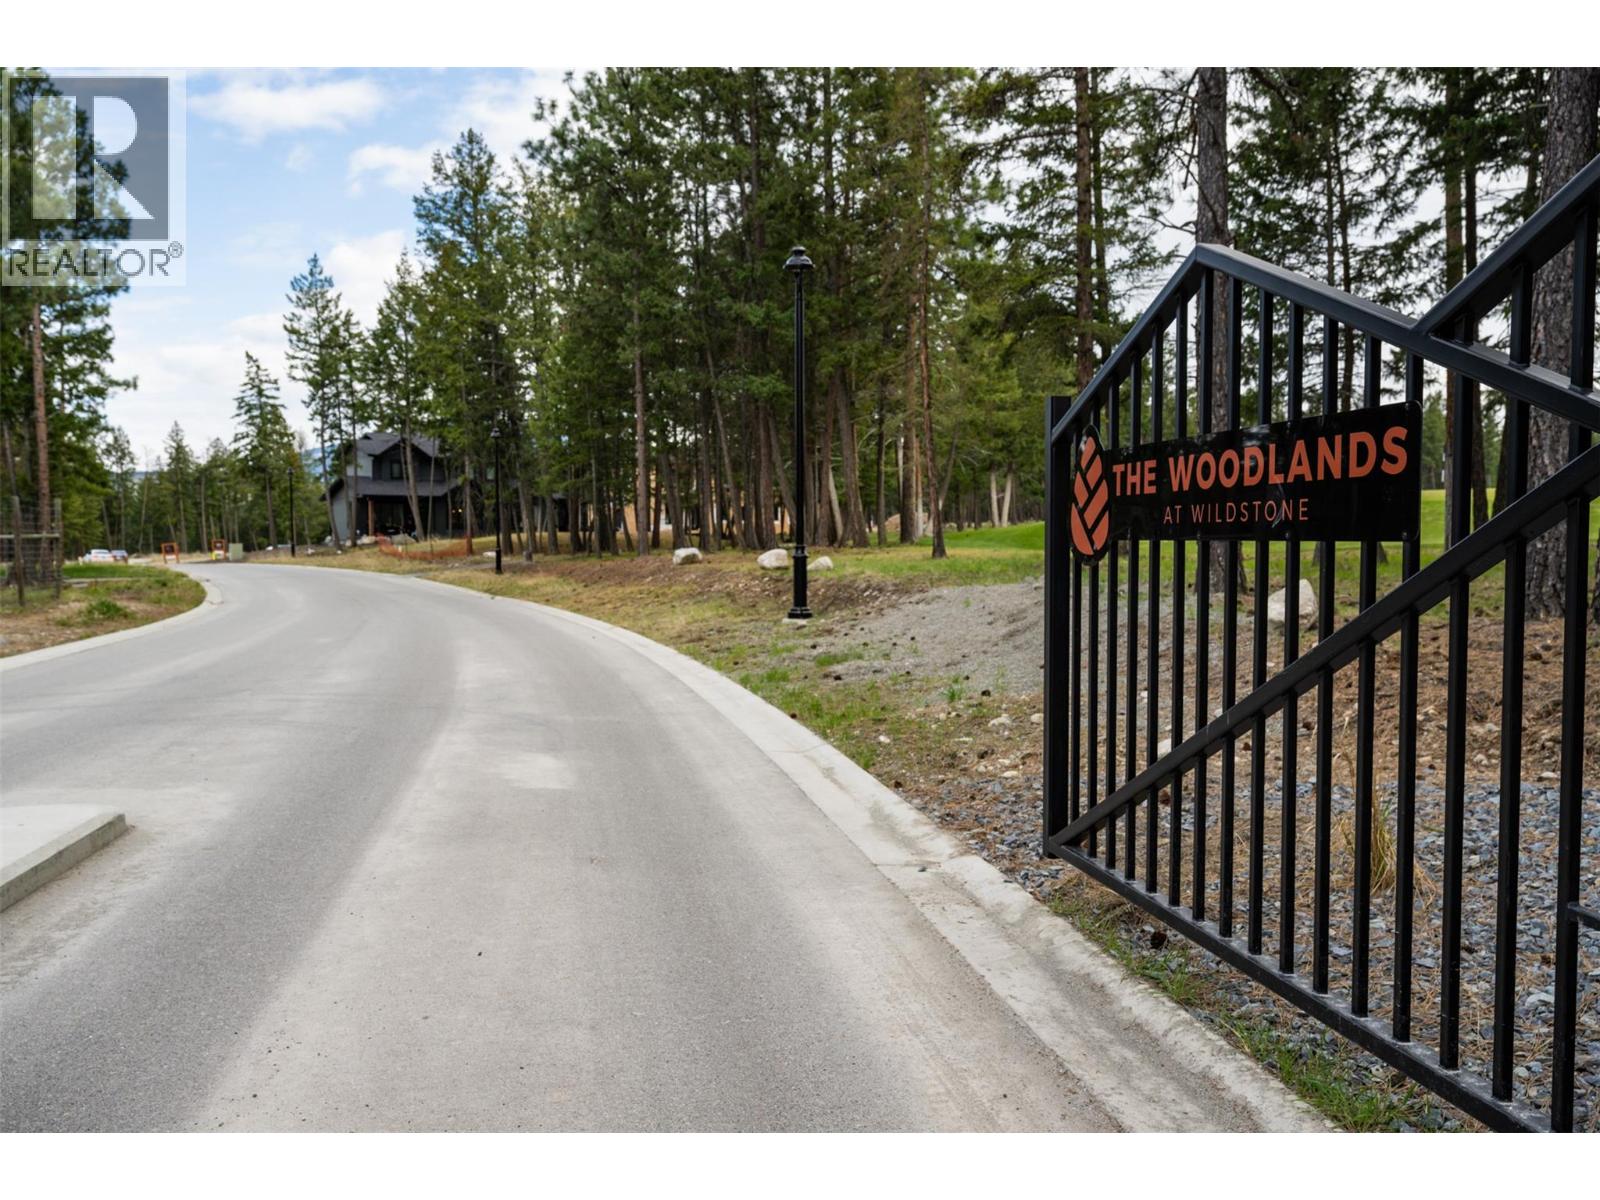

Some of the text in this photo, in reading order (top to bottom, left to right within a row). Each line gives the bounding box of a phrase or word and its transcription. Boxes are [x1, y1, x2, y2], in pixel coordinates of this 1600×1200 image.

[1112, 426, 1408, 496] THE WOODLANDS
[1163, 498, 1309, 525] AT WILDSTONE
